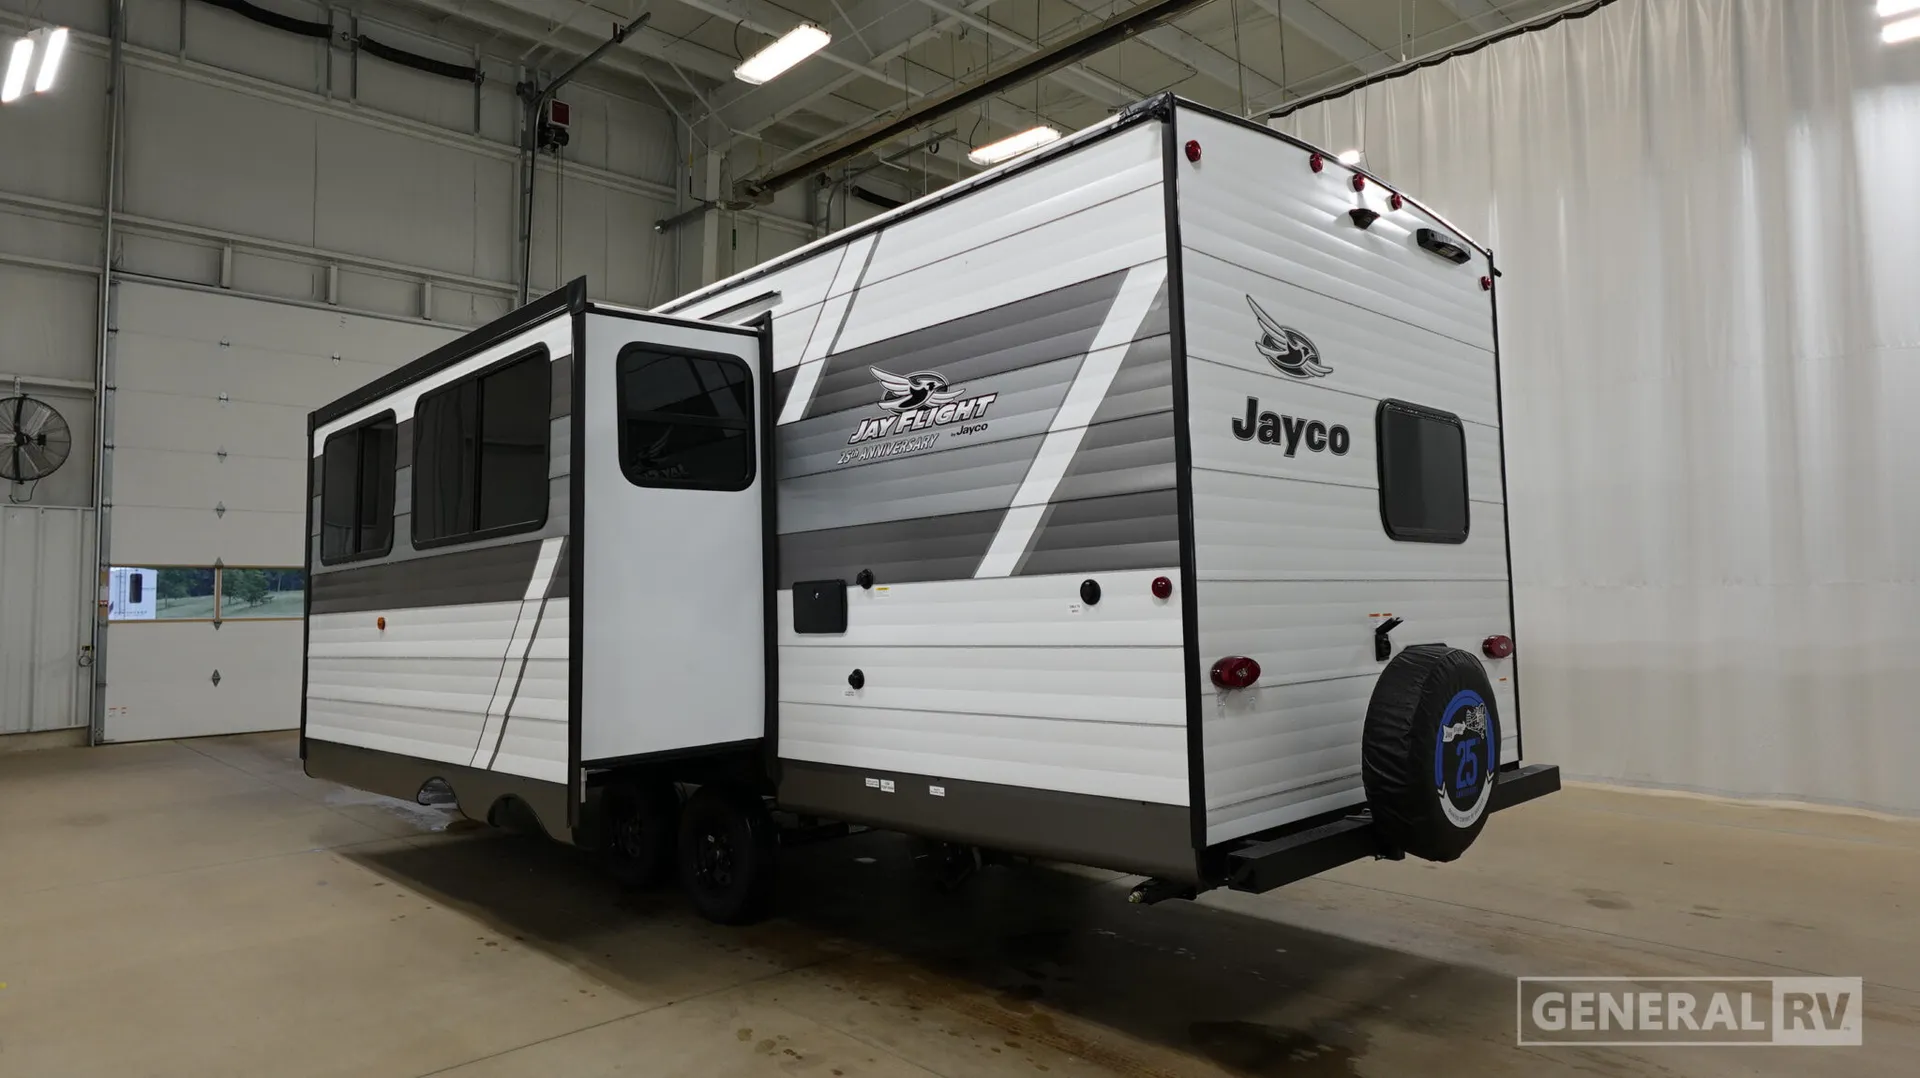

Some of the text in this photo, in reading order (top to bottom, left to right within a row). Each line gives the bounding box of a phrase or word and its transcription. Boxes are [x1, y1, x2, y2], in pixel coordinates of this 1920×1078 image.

[848, 392, 998, 444] JAY FLIGHT
[956, 423, 988, 436] Jayco
[1231, 396, 1350, 458] Jayco
[859, 433, 939, 460] ANNIVERSARY
[1455, 738, 1480, 790] 25
